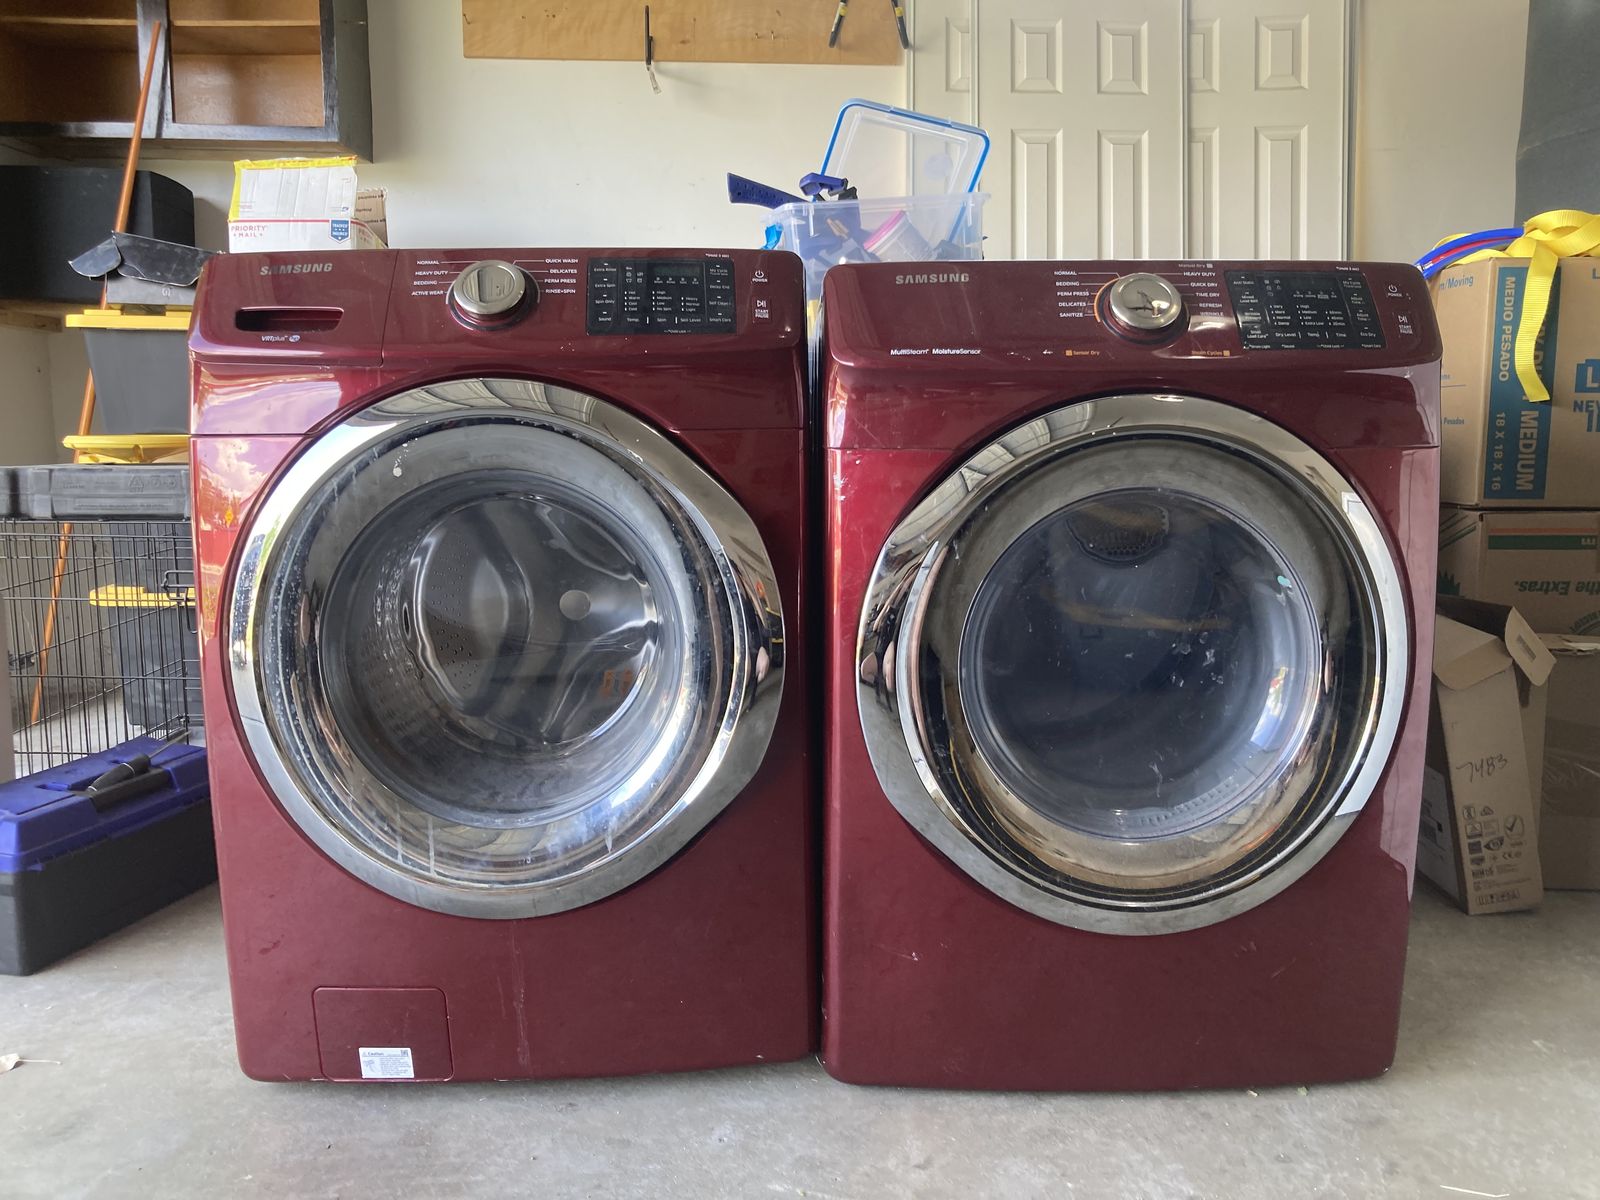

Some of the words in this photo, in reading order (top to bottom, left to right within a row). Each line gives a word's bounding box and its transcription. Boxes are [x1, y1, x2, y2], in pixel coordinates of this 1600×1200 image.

[260, 263, 333, 276] SAMSUNG
[895, 273, 970, 285] SAMSUNG
[1503, 276, 1516, 321] MEDIO
[1498, 325, 1513, 382] PESADO
[1495, 412, 1506, 427] 18
[1493, 445, 1504, 458] 18
[1516, 410, 1539, 490] MEDIUM
[1491, 477, 1501, 491] 16
[1514, 580, 1571, 596] Extras.
[1455, 753, 1508, 783] 7483
